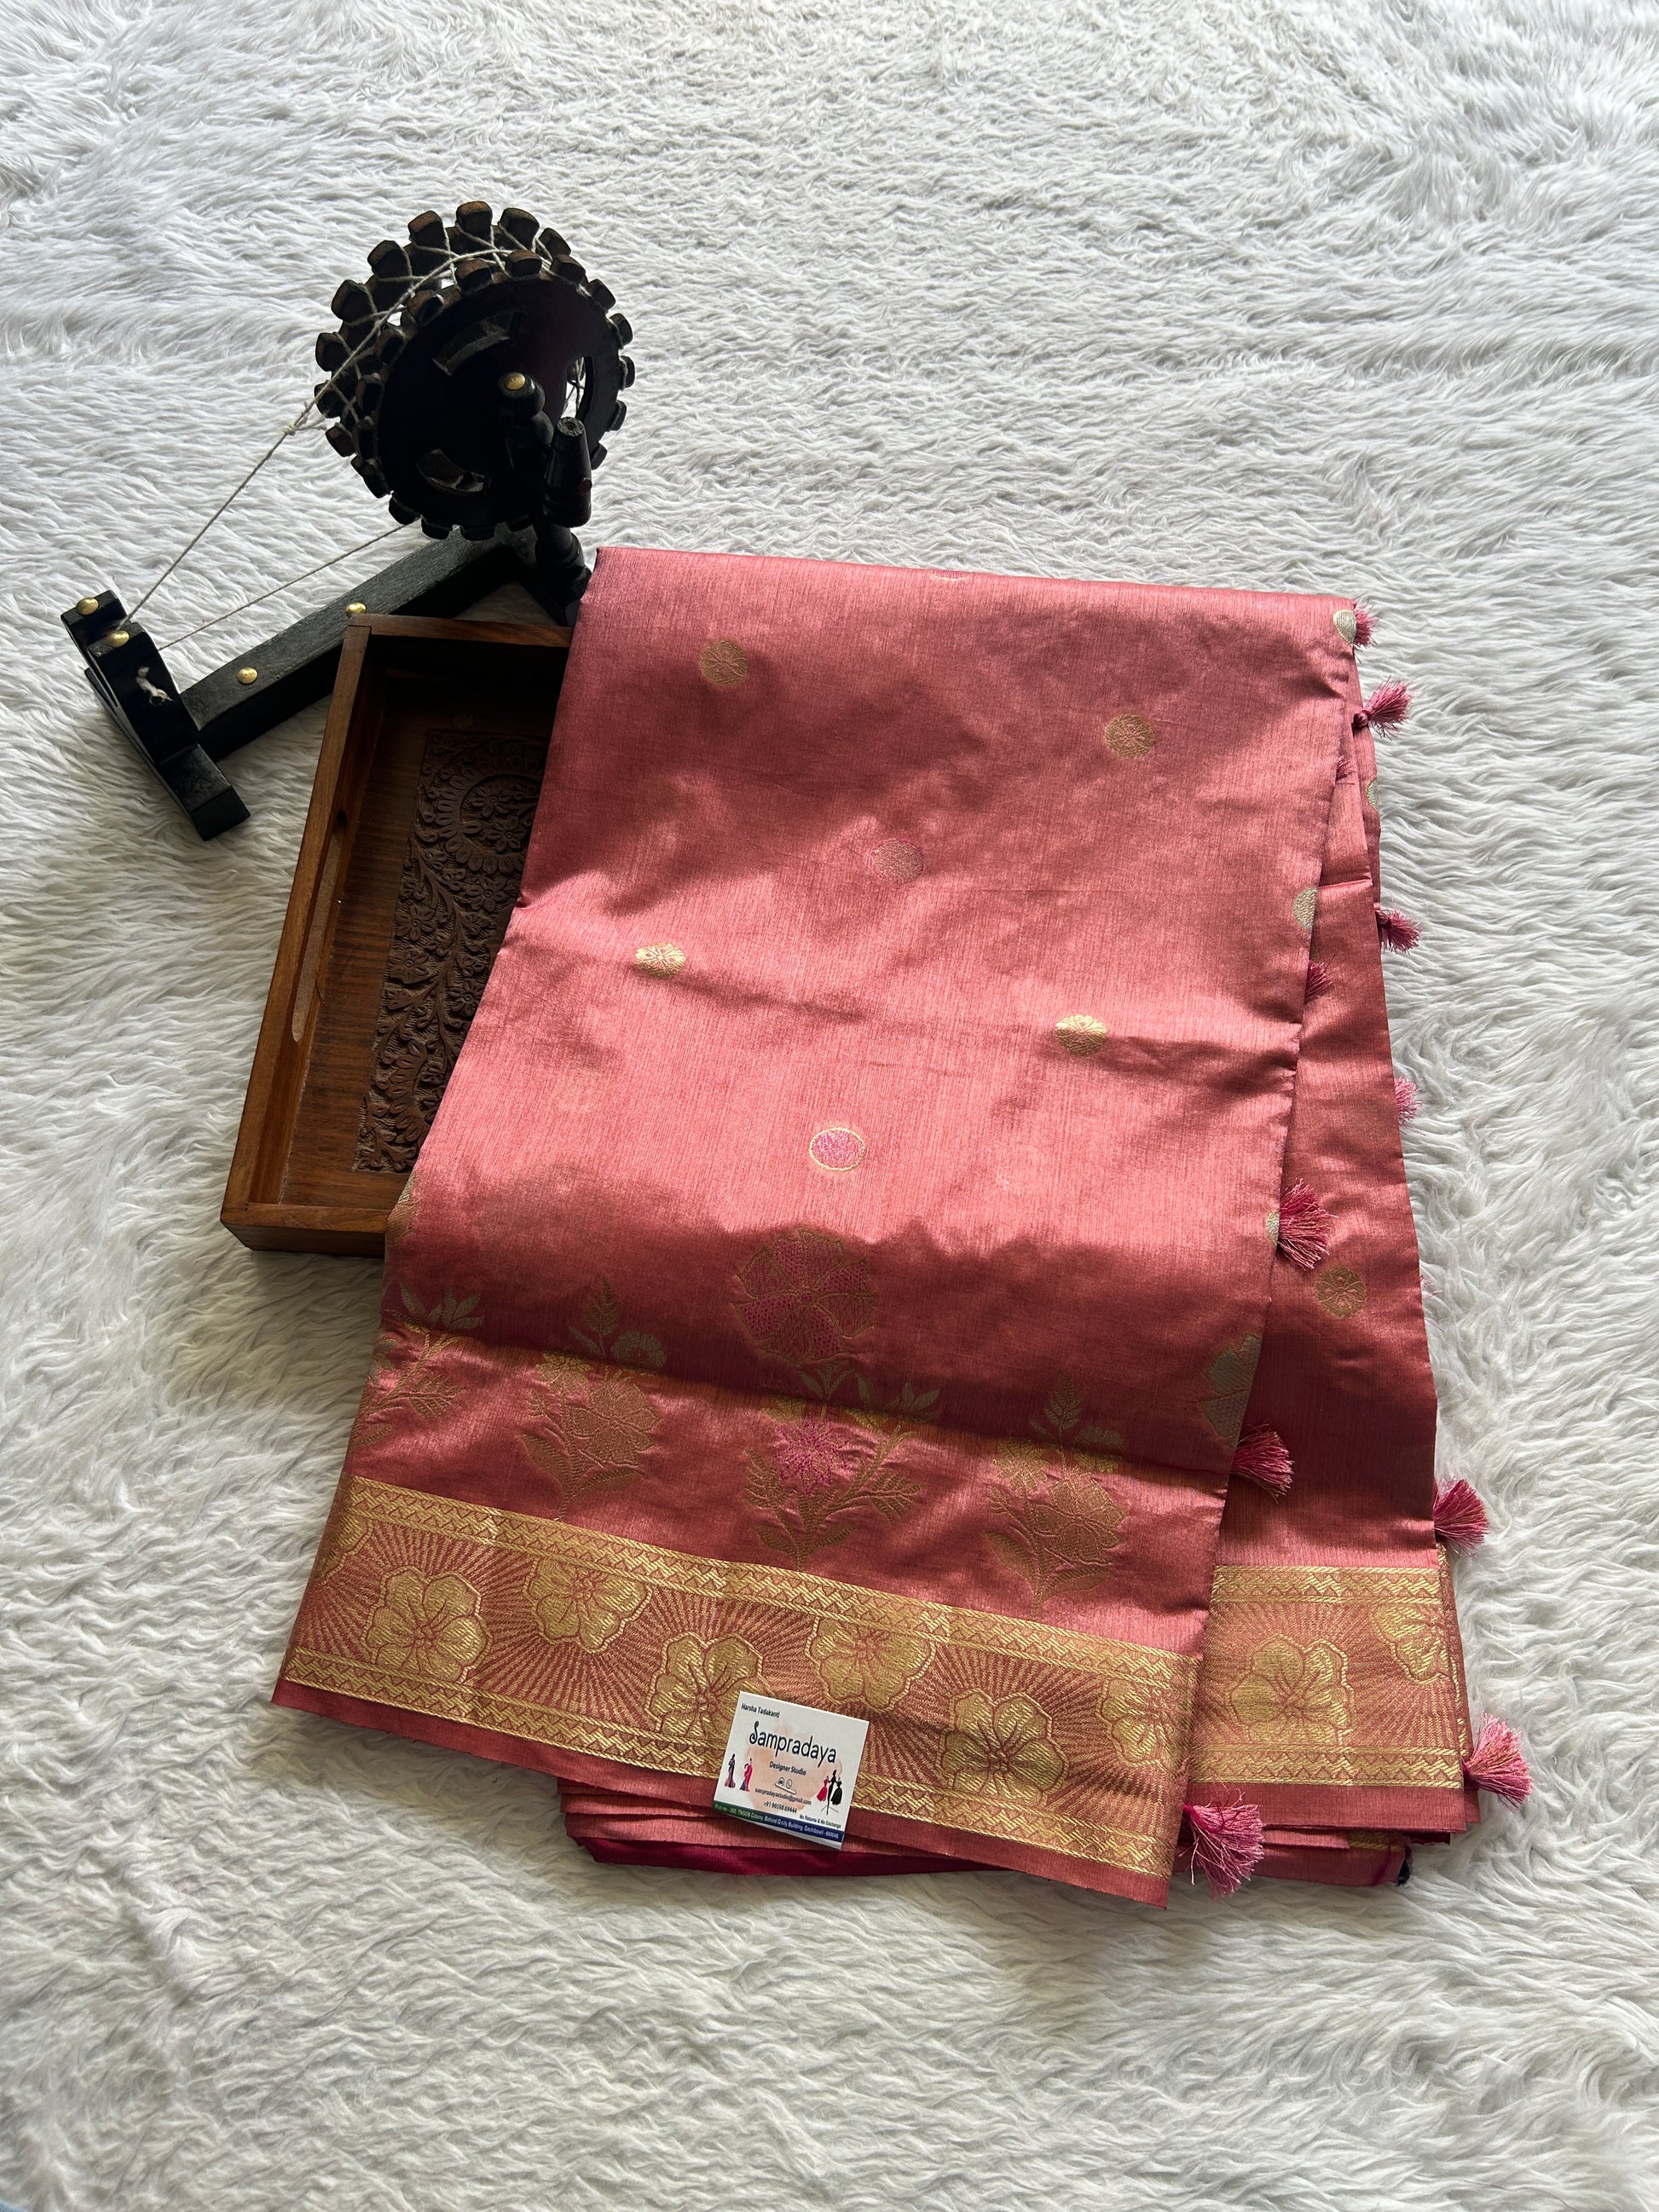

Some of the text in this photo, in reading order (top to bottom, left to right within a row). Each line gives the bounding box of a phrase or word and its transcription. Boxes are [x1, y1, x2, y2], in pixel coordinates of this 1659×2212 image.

[741, 1702, 757, 1712] Harsha
[749, 1720, 836, 1767] Sampradaya
[769, 1760, 806, 1776] Designer Studio
